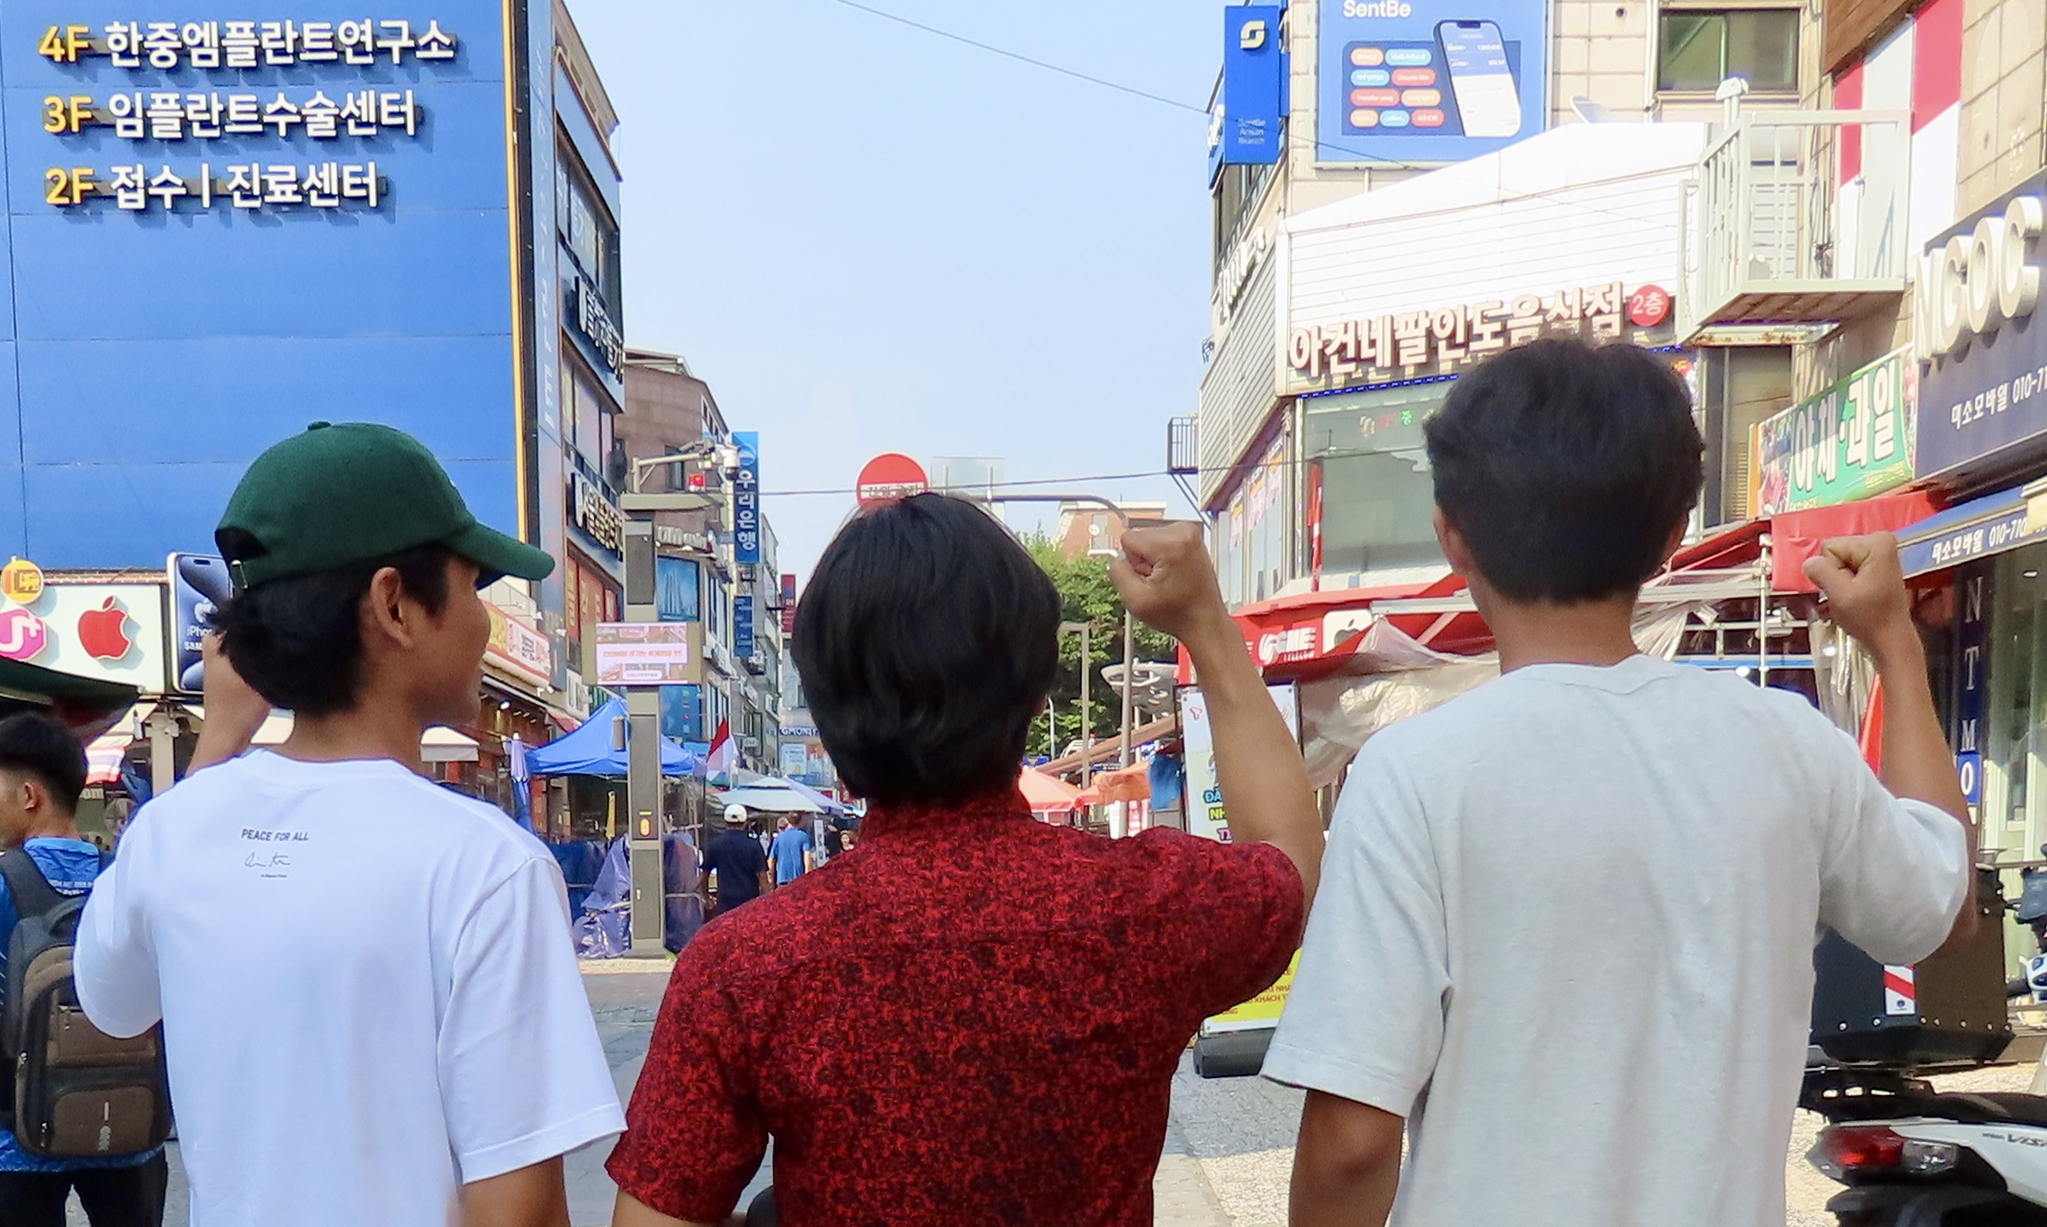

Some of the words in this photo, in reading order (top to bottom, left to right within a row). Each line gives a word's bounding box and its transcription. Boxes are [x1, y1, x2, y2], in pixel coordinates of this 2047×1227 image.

[1343, 0, 1411, 18] SentBe
[38, 26, 91, 62] 4F
[105, 19, 456, 68] 한중엠플란트연구소
[43, 96, 93, 134] 3F
[109, 89, 417, 139] 임플란트수술센터
[45, 167, 94, 205] 2F
[110, 163, 187, 210] 접수
[226, 161, 378, 209] 진료센터
[1913, 196, 2044, 362] NGOC
[1631, 292, 1664, 316] 2층
[736, 469, 757, 551] 우리은행
[184, 641, 203, 650] SAM
[241, 828, 272, 841] PEACE
[274, 832, 291, 841] FOR
[292, 831, 309, 841] ALL
